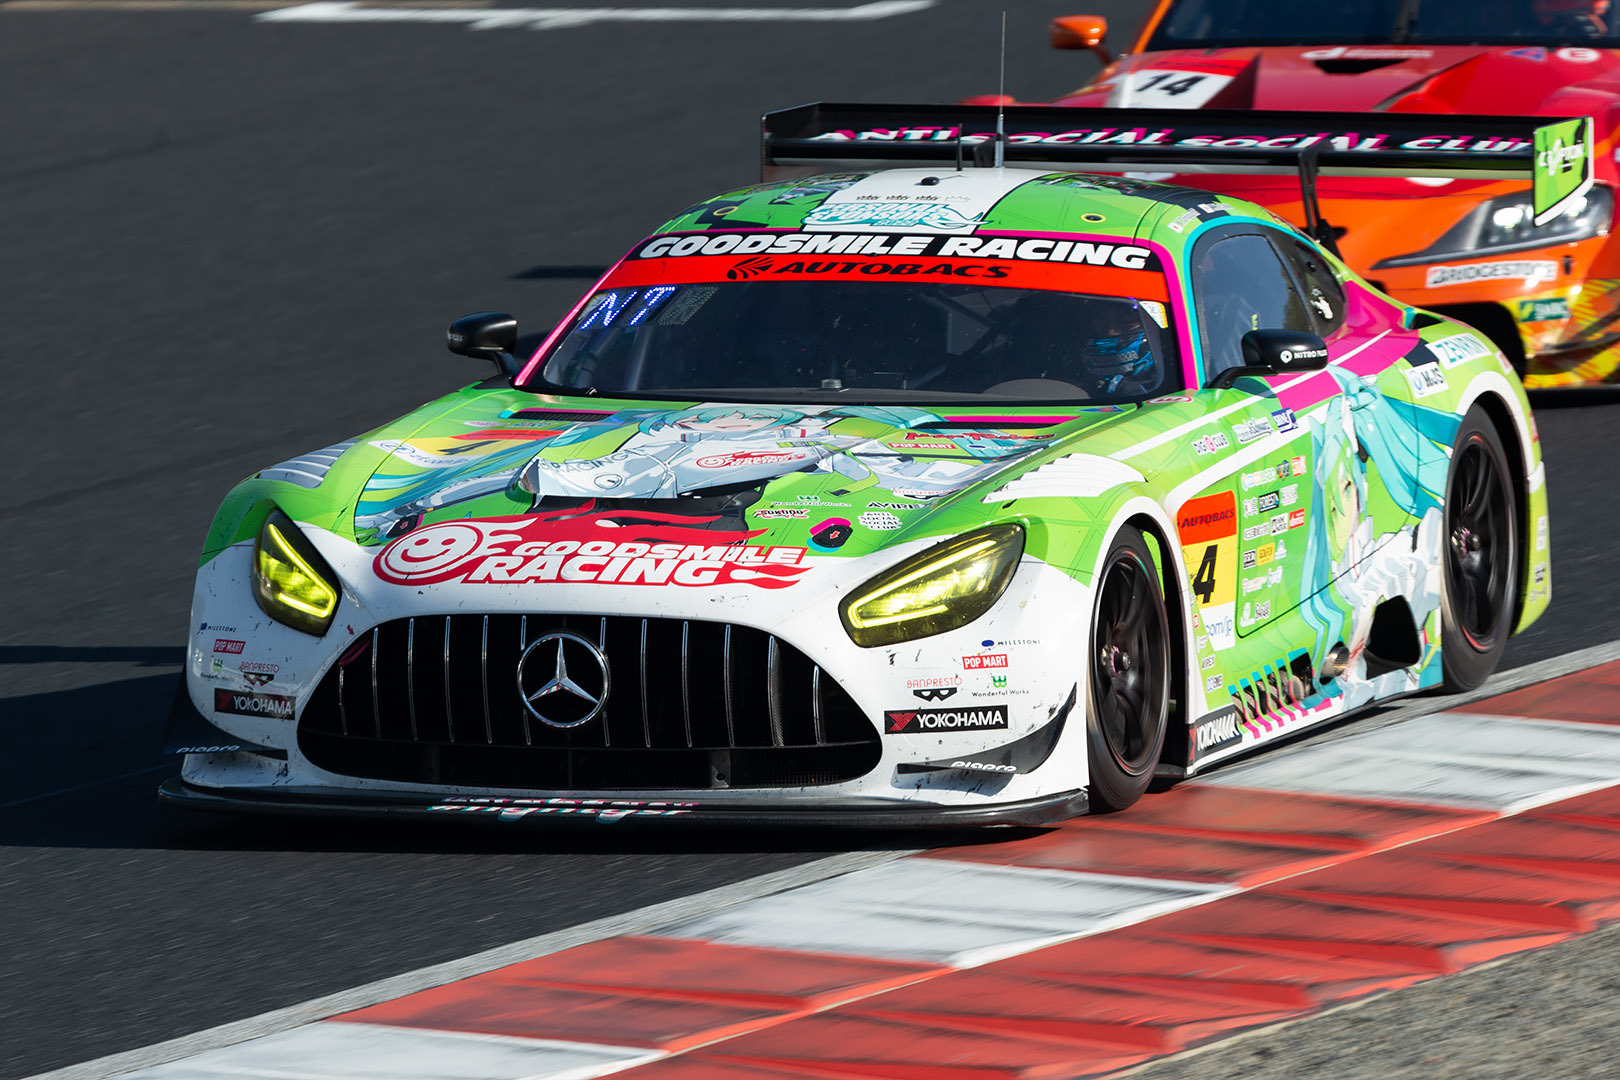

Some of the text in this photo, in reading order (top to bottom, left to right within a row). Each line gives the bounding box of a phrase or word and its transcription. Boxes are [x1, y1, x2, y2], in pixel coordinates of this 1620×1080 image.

[1136, 72, 1207, 95] 14
[814, 126, 959, 141] ANTI
[961, 128, 1175, 145] SOCIAL
[1174, 132, 1390, 151] SOCIAL
[640, 234, 1152, 269] GOODSMILE RACING
[773, 256, 1011, 279] AUTOBACS
[1294, 350, 1316, 359] NITRO
[437, 439, 501, 456] 4
[1182, 508, 1235, 528] AUTOBACS
[512, 541, 803, 564] GOODSMILE
[469, 554, 725, 583] RACING
[1192, 544, 1219, 605] 4
[215, 639, 244, 654] POP MART
[241, 661, 280, 674] BANPRESTO
[964, 654, 1007, 668] POP MART
[906, 676, 963, 689] BANPRESTO
[233, 695, 293, 715] YOKOHAMA
[916, 710, 1004, 729] YOKOHAMA
[1197, 713, 1240, 751] YOKOHAMA
[176, 745, 241, 754] piapro
[950, 761, 1017, 772] piapro
